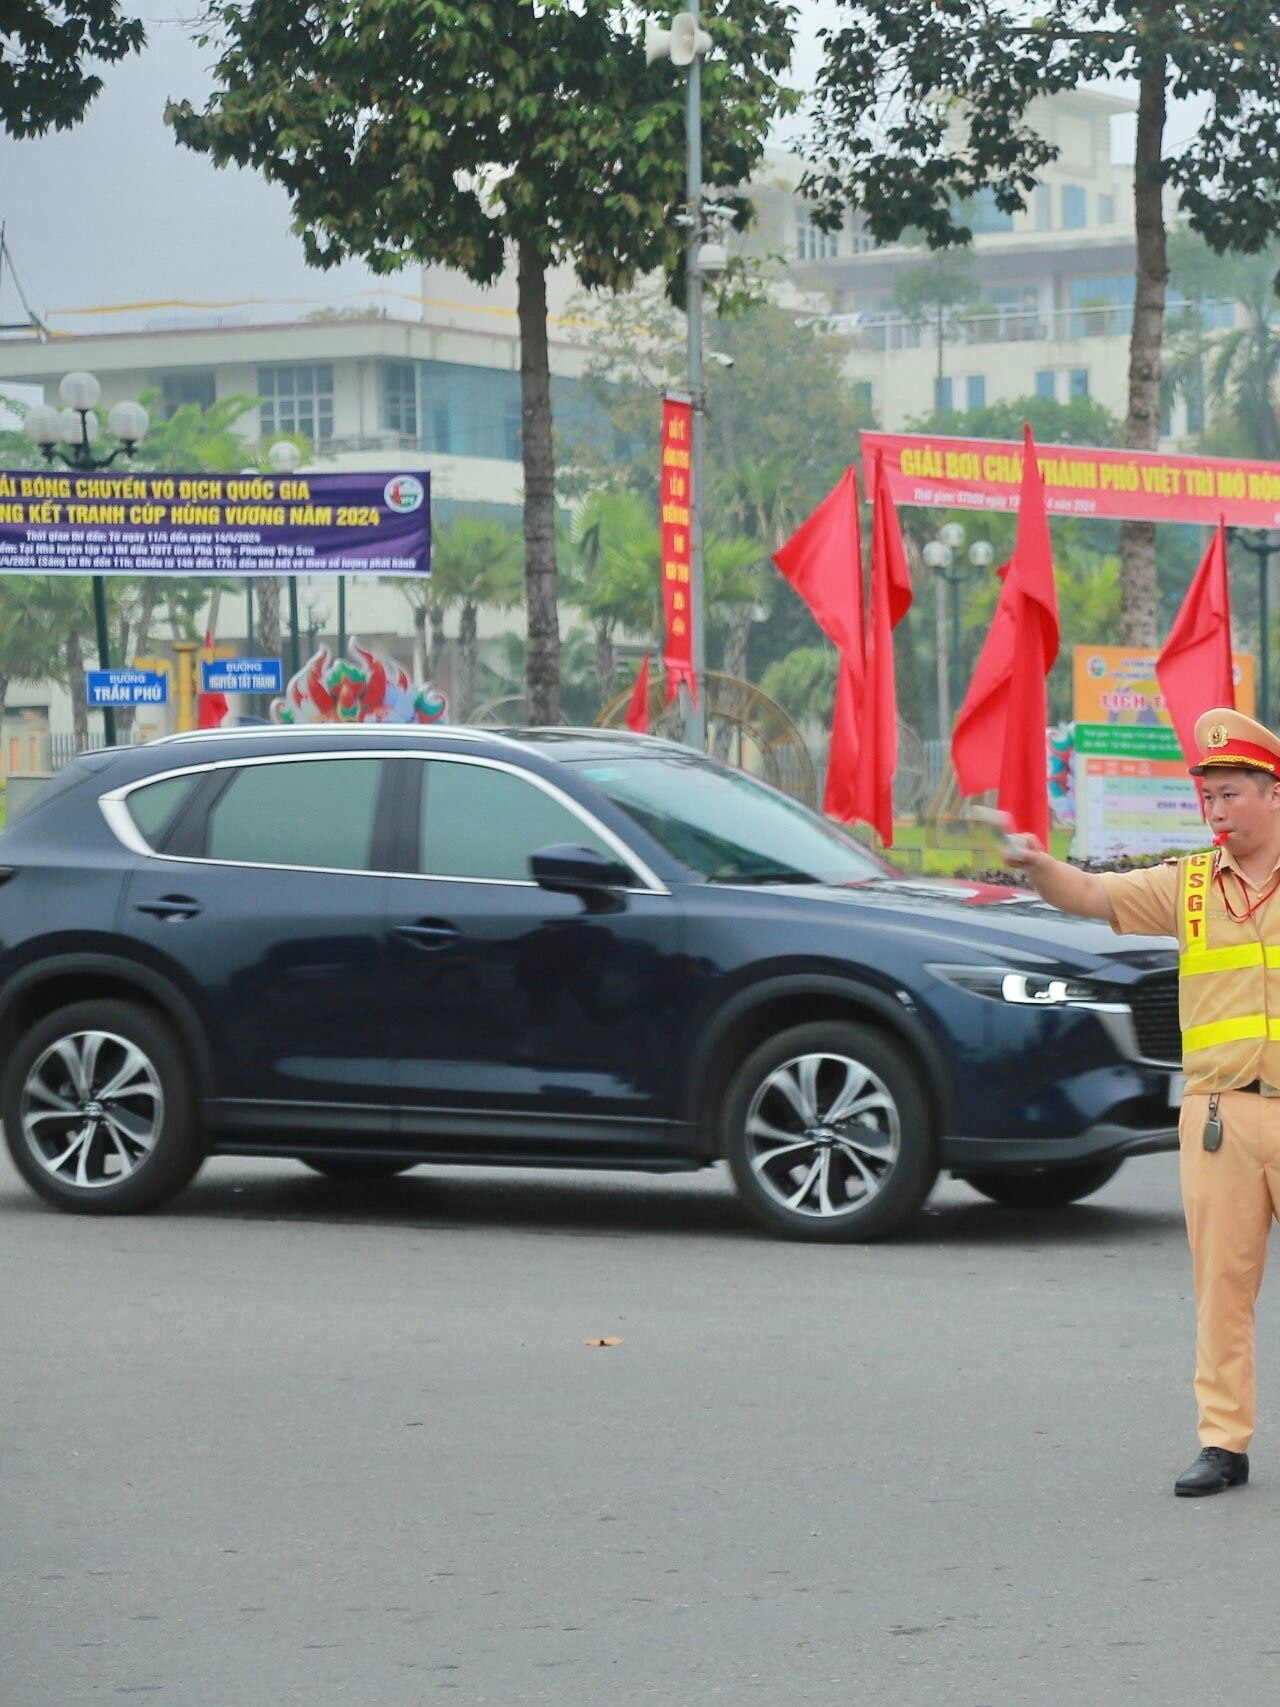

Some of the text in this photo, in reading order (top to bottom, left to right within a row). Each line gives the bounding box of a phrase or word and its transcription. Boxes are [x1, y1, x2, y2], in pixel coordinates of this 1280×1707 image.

[21, 475, 71, 498] BÓNG
[178, 479, 222, 503] ĐỊCH
[226, 476, 274, 502] QUỐC
[279, 480, 310, 501] GIA
[1099, 460, 1138, 492] PHỐ
[1140, 463, 1181, 497] VIỆT
[1182, 465, 1215, 497] TRÌ
[29, 498, 62, 524] KẾT
[66, 504, 125, 525] TRANH
[129, 501, 166, 525] CÚP
[171, 501, 220, 525] HÙNG
[225, 504, 285, 526] VƯƠNG
[289, 503, 332, 526] NĂM
[336, 506, 381, 527] 2024
[133, 682, 163, 702] PHÚ
[1187, 855, 1206, 938] CSGT
